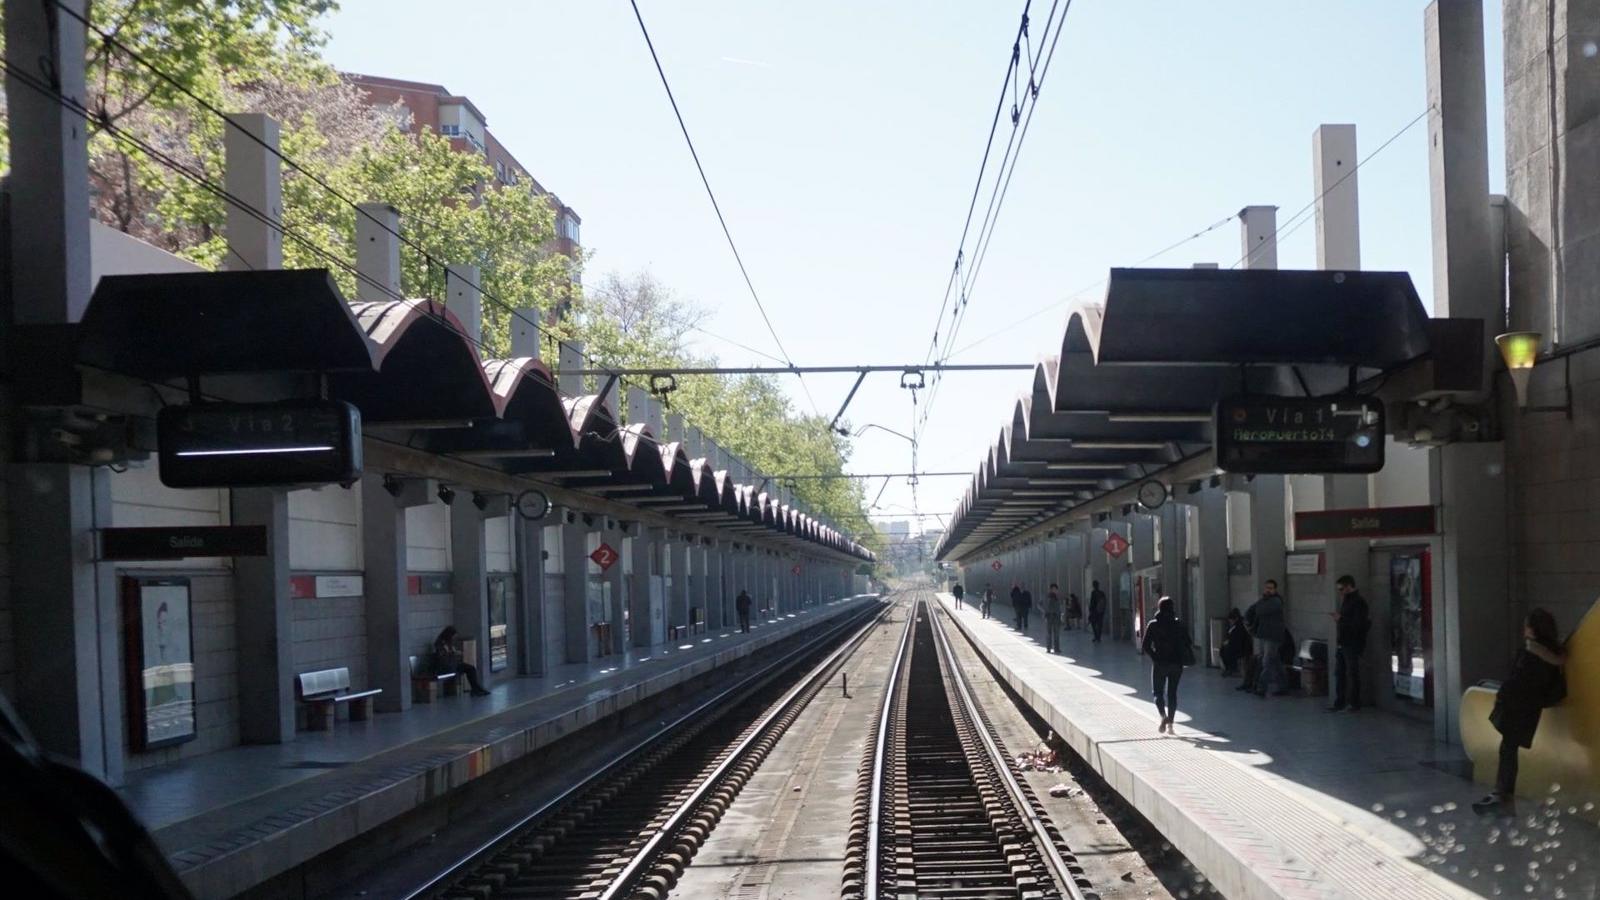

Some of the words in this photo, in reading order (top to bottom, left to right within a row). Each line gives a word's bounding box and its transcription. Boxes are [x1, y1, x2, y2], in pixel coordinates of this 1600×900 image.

[281, 414, 294, 431] 2
[1315, 407, 1324, 424] 1
[1351, 517, 1380, 529] Salida
[169, 535, 204, 548] Salida
[1111, 540, 1120, 553] 1
[600, 549, 611, 564] 2
